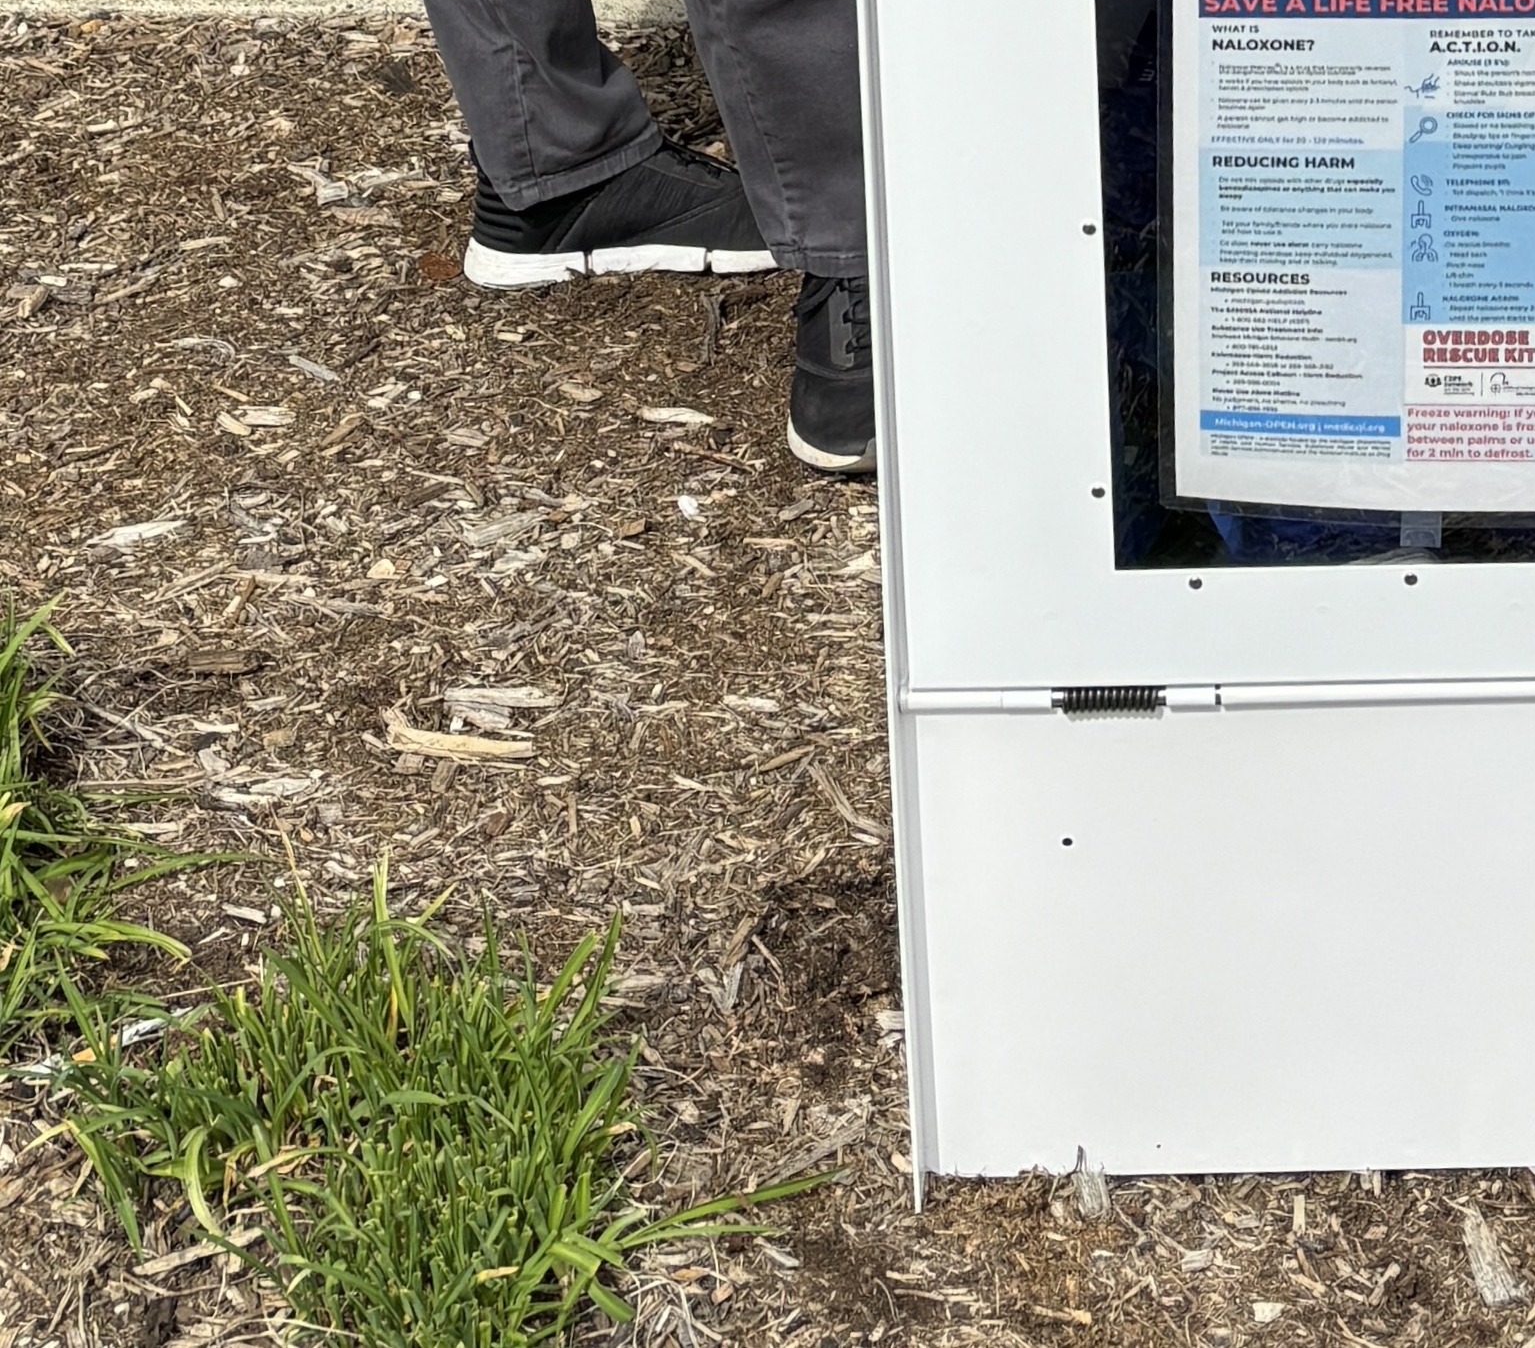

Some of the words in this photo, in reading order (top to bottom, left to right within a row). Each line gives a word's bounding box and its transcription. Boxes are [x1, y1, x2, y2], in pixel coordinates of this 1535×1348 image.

[1212, 25, 1245, 33] WHAT
[1249, 25, 1260, 33] IS
[1430, 30, 1494, 39] REMEMBER
[1499, 29, 1513, 38] TO
[1212, 39, 1315, 51] NALOXONE?
[1429, 41, 1521, 53] A.C.T.I.O.N.
[1212, 156, 1299, 168] REDUCING
[1305, 157, 1355, 169] HARM
[1211, 271, 1310, 284] RESOURCES
[1423, 330, 1530, 346] OVERDOSE
[1423, 348, 1500, 363] RESCUE
[1408, 408, 1450, 418] Freeze
[1454, 409, 1510, 420] warning:
[1514, 409, 1524, 418] If
[1407, 423, 1436, 433] your
[1440, 422, 1498, 432] naloxone
[1502, 421, 1512, 431] is
[1407, 435, 1464, 445] between
[1467, 435, 1506, 446] palms
[1510, 437, 1523, 445] or
[1407, 449, 1425, 458] for
[1428, 449, 1436, 458] 2
[1439, 449, 1464, 458] min
[1468, 450, 1481, 458] to
[1484, 449, 1533, 458] defrost.
